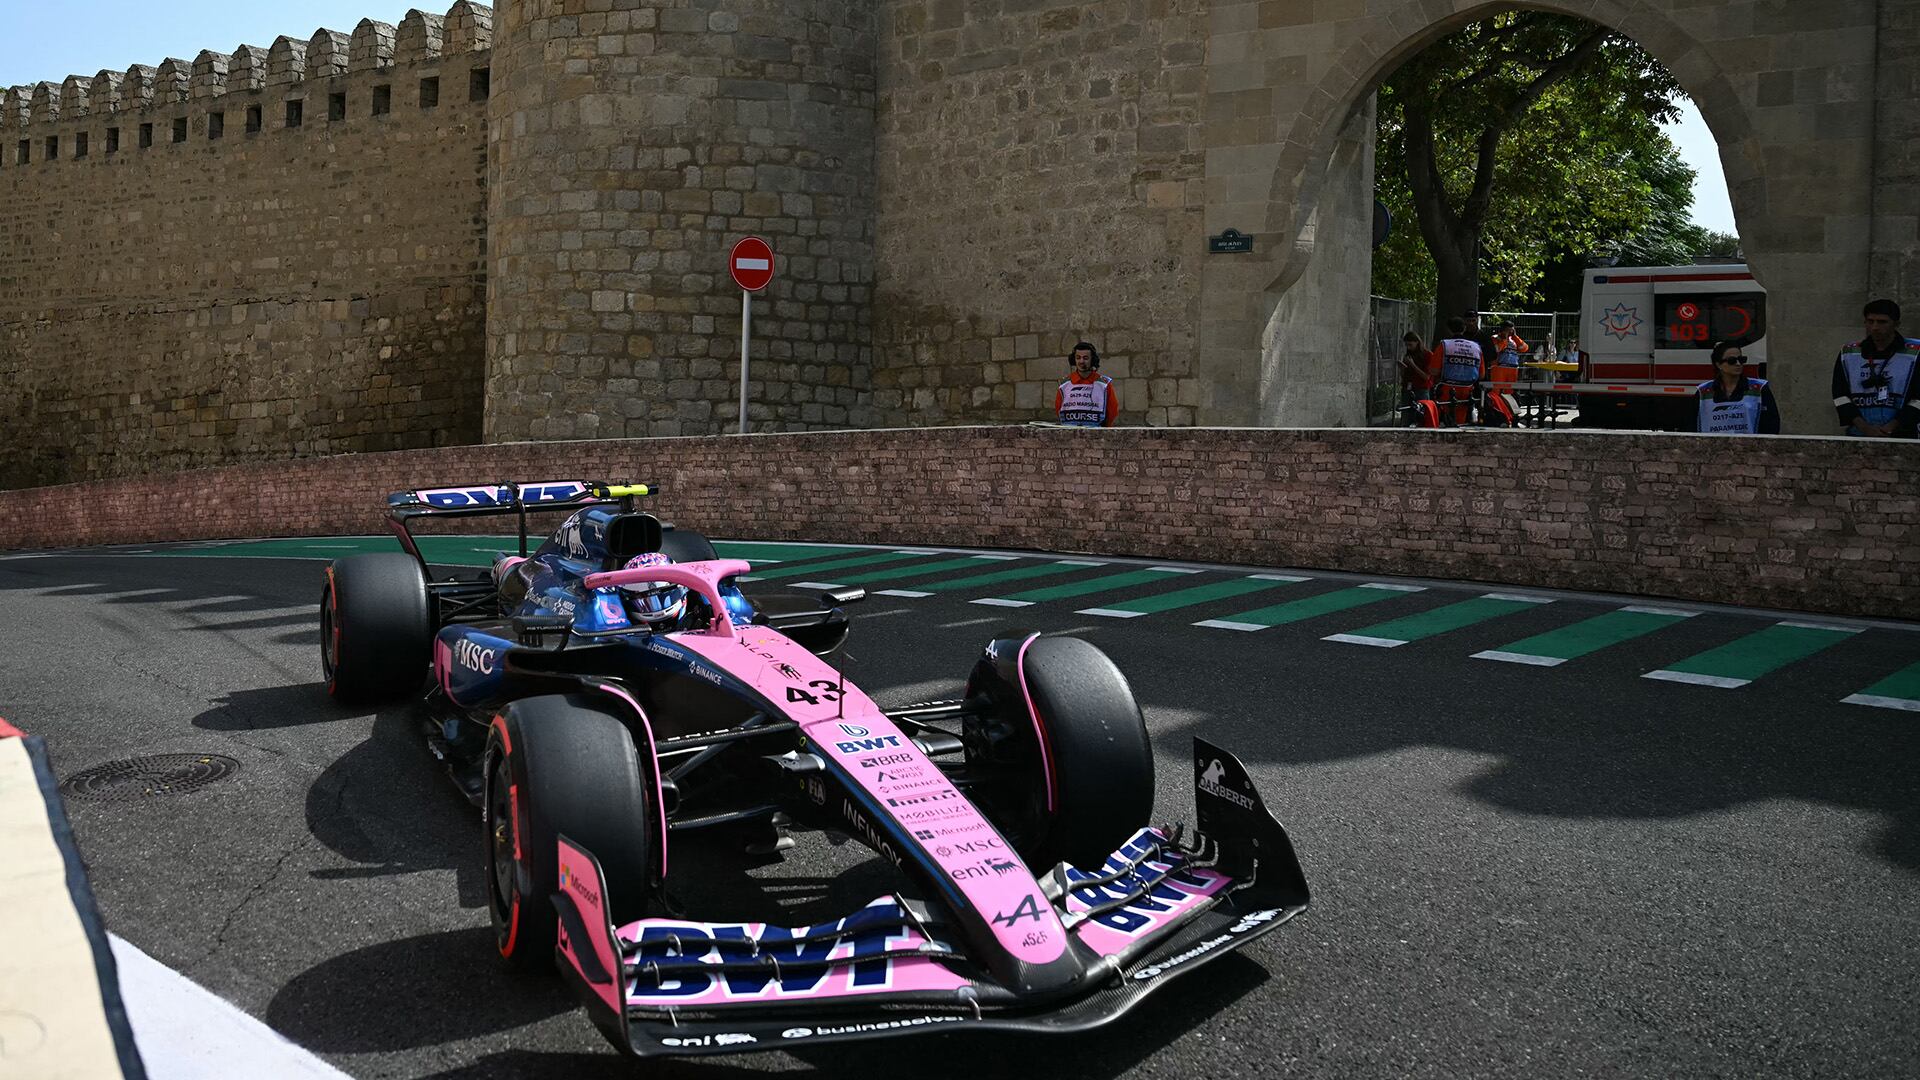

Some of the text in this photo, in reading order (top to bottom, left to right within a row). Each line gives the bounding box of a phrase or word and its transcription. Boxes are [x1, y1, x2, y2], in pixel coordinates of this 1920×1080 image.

[1668, 322, 1711, 343] 103
[1852, 396, 1896, 407] COURE
[1065, 412, 1099, 421] COURSE
[460, 638, 496, 675] MSC
[695, 665, 722, 686] BINANCE
[786, 680, 848, 706] 43
[835, 735, 902, 755] BWT
[878, 752, 914, 766] BRB
[892, 778, 945, 791] BINANCE
[886, 789, 958, 808] PIRELLI
[899, 804, 969, 821] MOBILIZE
[954, 837, 1005, 855] MSC
[951, 861, 989, 880] eni
[628, 900, 908, 999] BWT
[815, 1016, 965, 1036] businessolver
[661, 1035, 711, 1048] eni
